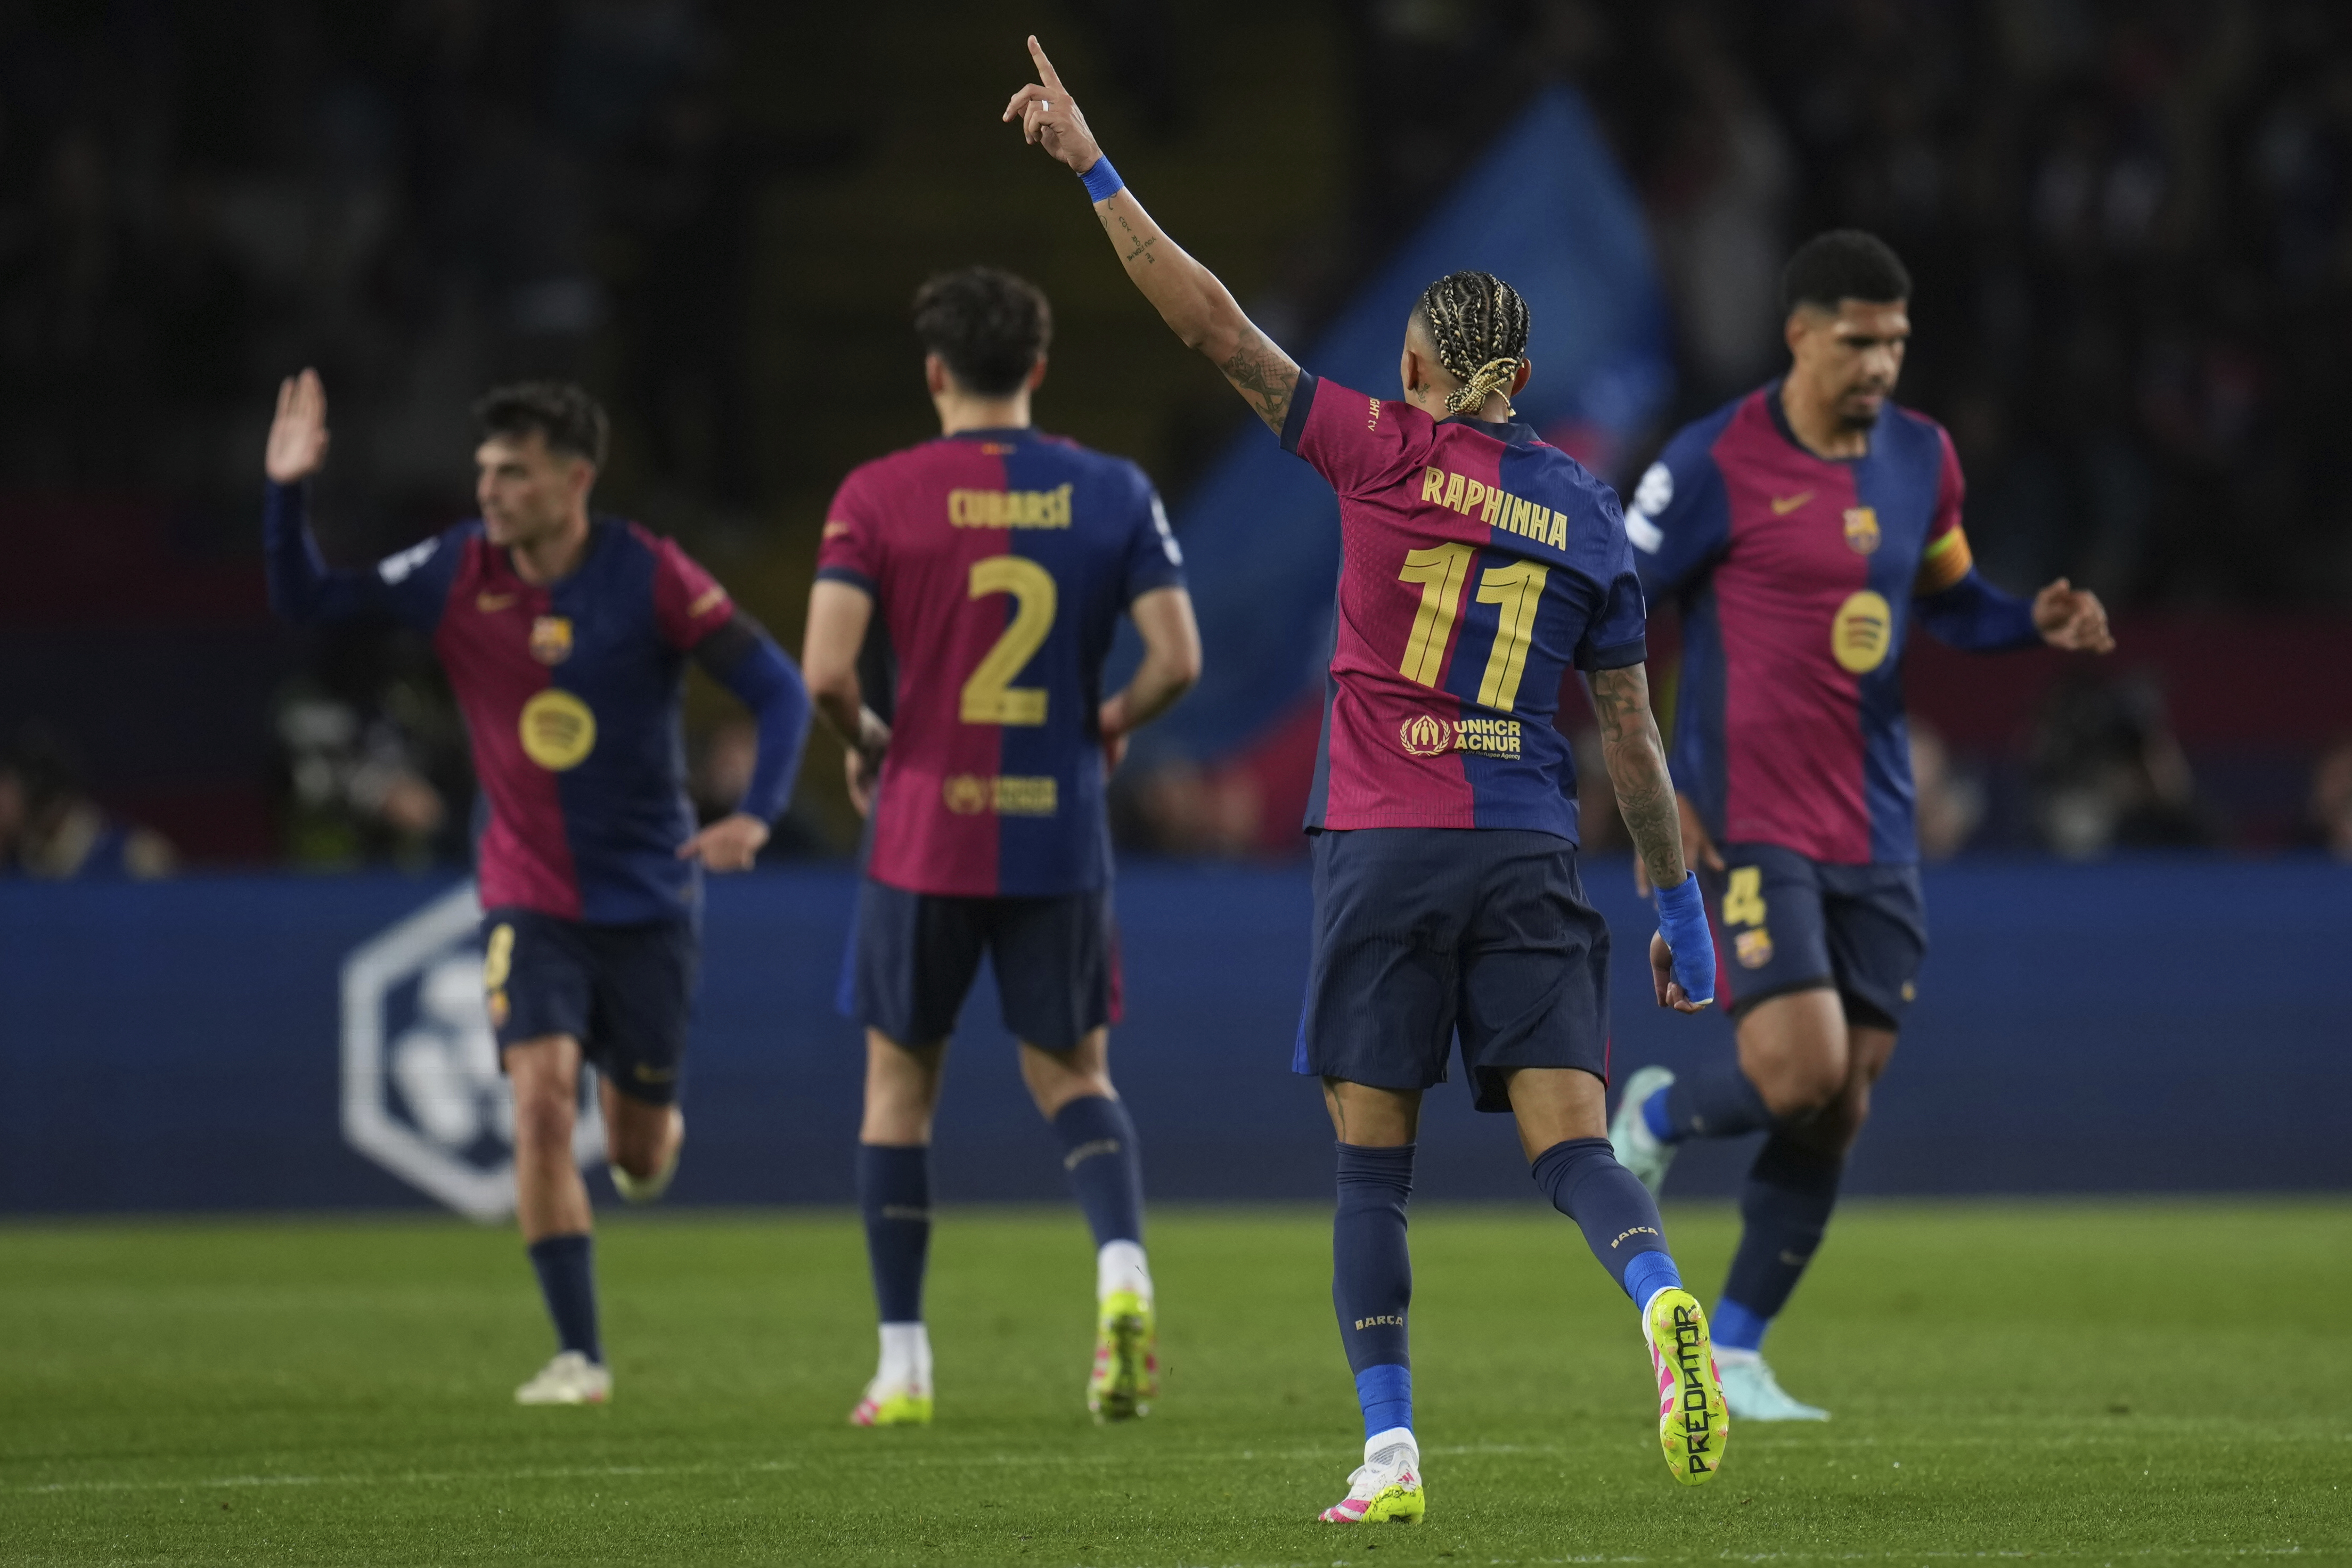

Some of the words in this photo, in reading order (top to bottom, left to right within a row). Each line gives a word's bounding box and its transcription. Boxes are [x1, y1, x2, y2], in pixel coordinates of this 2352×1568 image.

[1368, 420, 1377, 431] tv
[1422, 466, 1567, 551] RAPHINHA
[962, 556, 1057, 726] 2
[1398, 542, 1550, 713] 11
[1453, 719, 1521, 736] UNHCR
[1453, 734, 1521, 752] ACNUR
[1500, 752, 1521, 761] Agency
[1722, 865, 1766, 926] 4
[1673, 1304, 1712, 1474] PREDATOR
